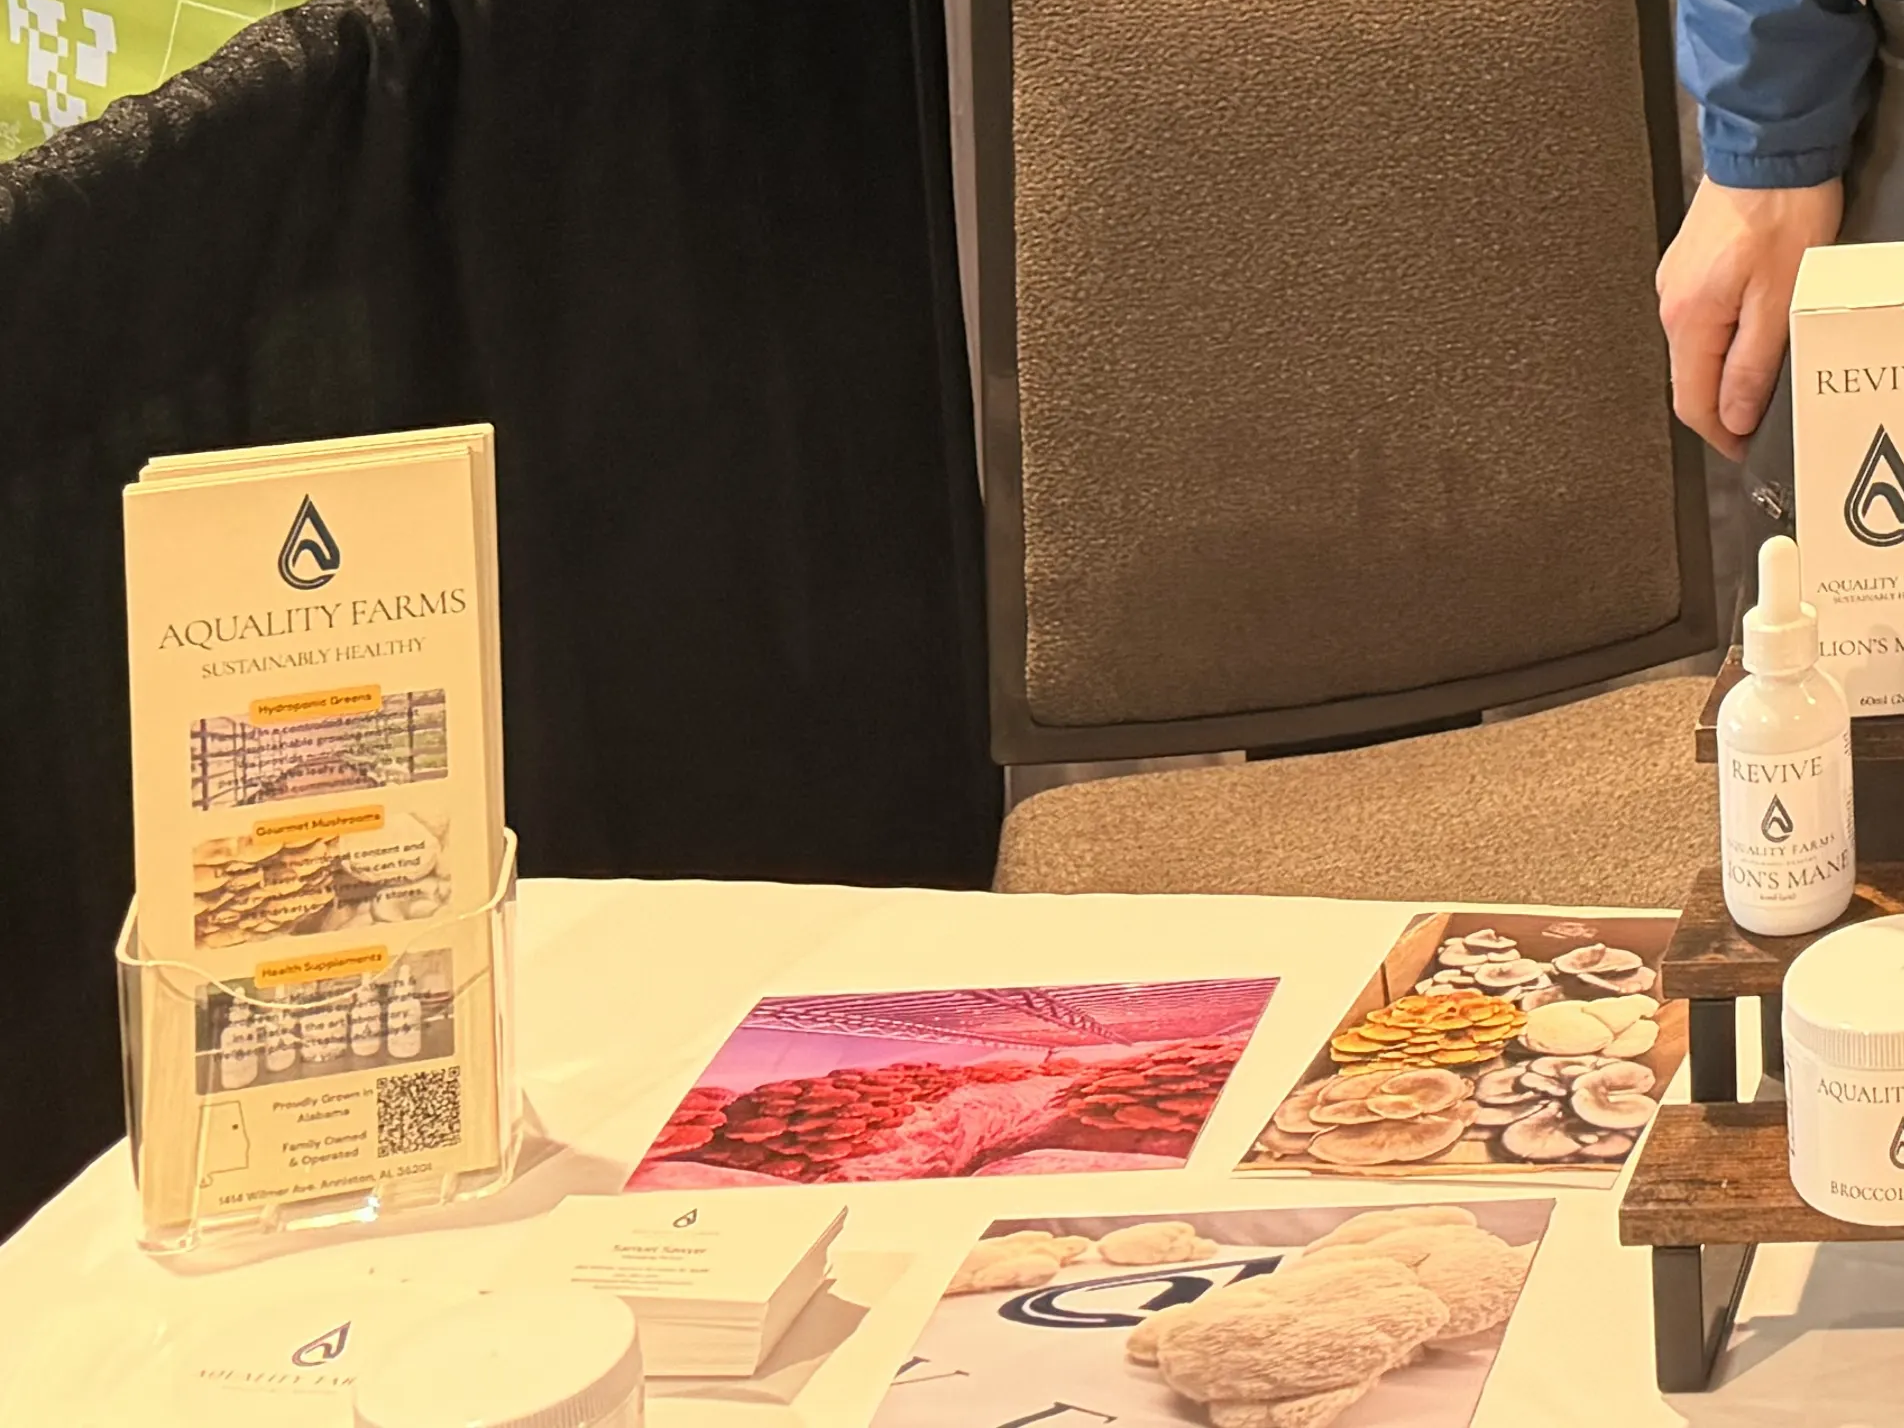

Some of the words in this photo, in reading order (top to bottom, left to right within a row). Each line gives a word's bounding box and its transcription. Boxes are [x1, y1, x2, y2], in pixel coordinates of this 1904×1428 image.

[1817, 576, 1898, 594] AQUALITY
[158, 603, 342, 650] AQUALITY
[351, 588, 467, 626] FARMS
[1819, 638, 1888, 657] LION'S
[201, 648, 332, 679] SUSTAINABLY
[336, 637, 426, 663] HEALTHY
[330, 693, 372, 706] Greens
[1732, 756, 1823, 784] REVIVE
[256, 821, 309, 837] Gourmet
[262, 964, 301, 978] Health
[305, 953, 383, 973] Supplements
[273, 1096, 317, 1112] Proudly
[364, 1088, 374, 1098] in
[297, 1108, 350, 1123] Alabama
[283, 1137, 320, 1153] Family
[324, 1131, 367, 1145] Owned
[302, 1148, 359, 1167] Operated
